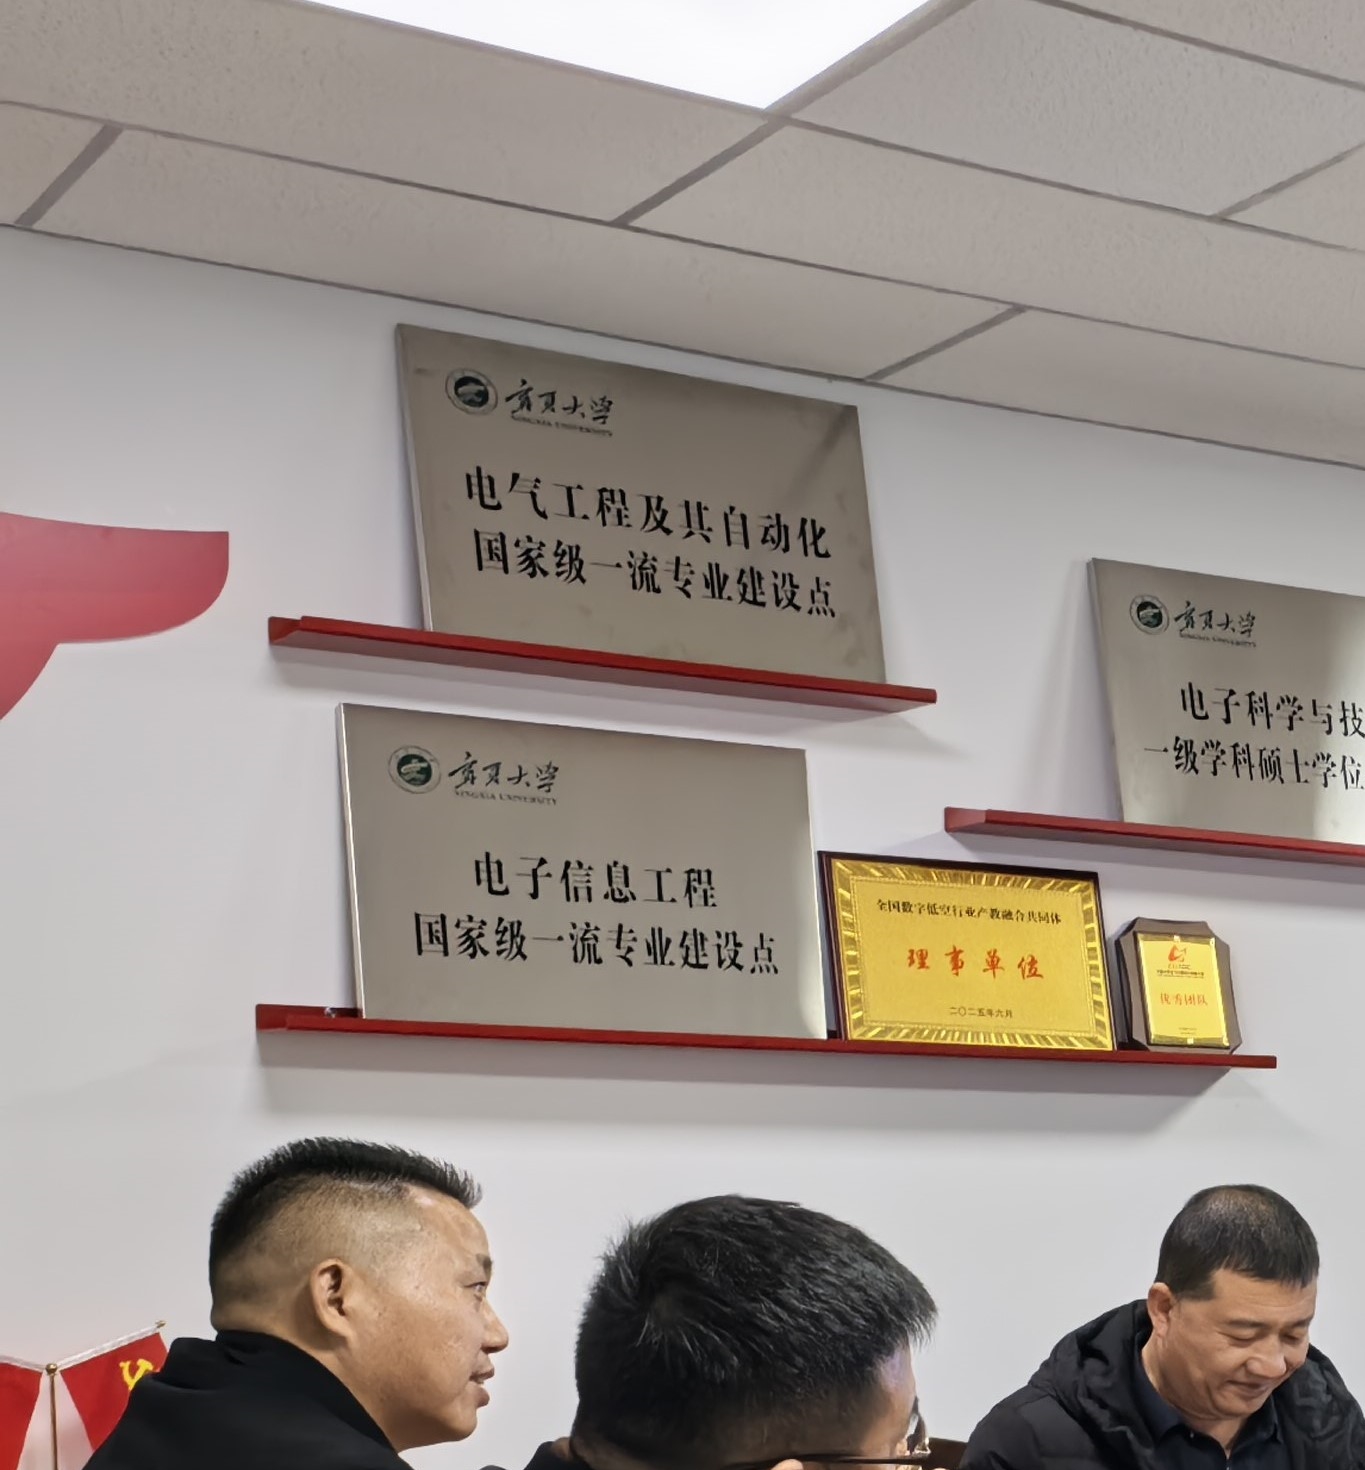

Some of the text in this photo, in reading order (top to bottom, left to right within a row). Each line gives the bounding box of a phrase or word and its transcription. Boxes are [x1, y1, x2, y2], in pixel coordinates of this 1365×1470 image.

[466, 465, 832, 560] 电气工程及其自动化
[473, 527, 836, 619] 国家级一流专业建设点
[474, 851, 718, 910] 电子信息工程
[413, 911, 779, 975] 国家级一流专业建设点
[906, 944, 1045, 981] 理事单位
